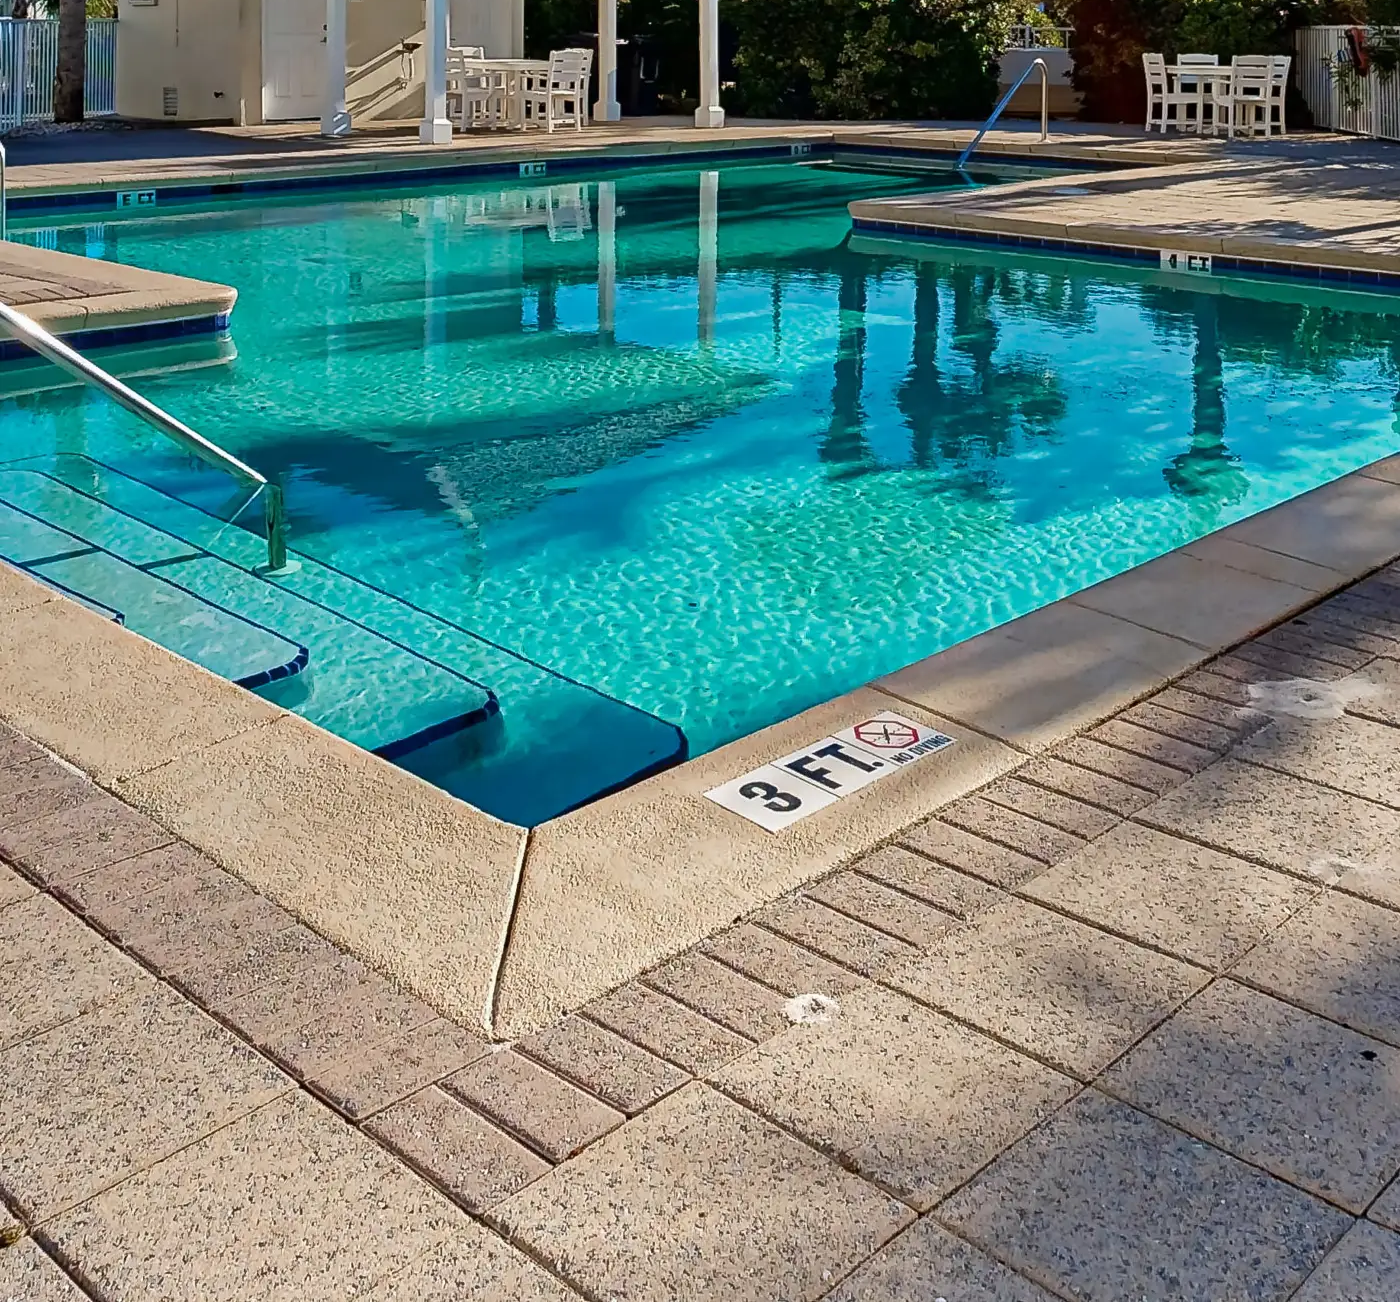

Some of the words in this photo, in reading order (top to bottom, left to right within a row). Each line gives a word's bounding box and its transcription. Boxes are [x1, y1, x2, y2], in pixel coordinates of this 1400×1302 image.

[889, 752, 914, 764] NO
[908, 735, 952, 755] DIVING
[739, 781, 802, 812] 3
[784, 743, 884, 790] FT.
